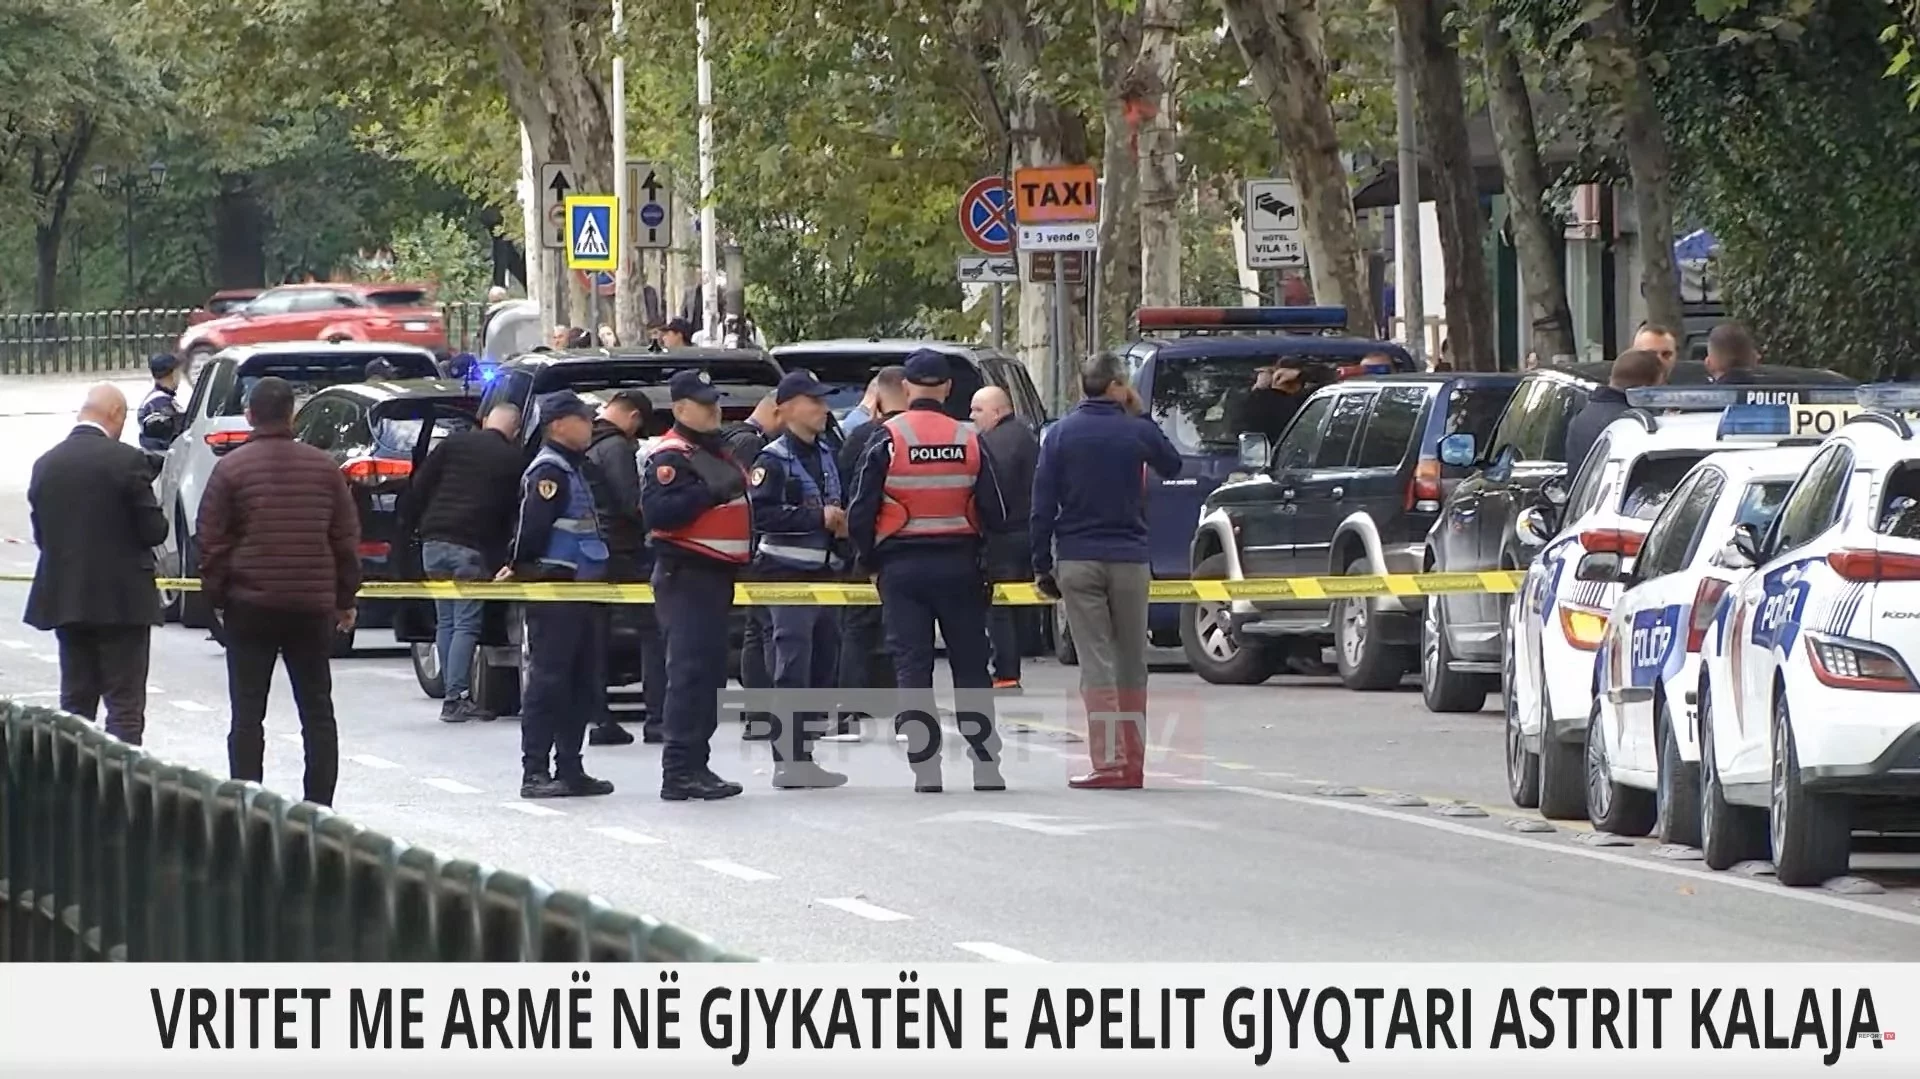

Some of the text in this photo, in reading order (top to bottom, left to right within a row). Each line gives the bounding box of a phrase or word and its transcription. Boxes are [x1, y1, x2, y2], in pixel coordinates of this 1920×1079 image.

[1021, 181, 1092, 207] TAXI
[1036, 232, 1080, 242] 3 vende
[1255, 244, 1280, 253] VILA
[1747, 391, 1800, 405] POLICIA
[910, 447, 964, 460] POLICIA
